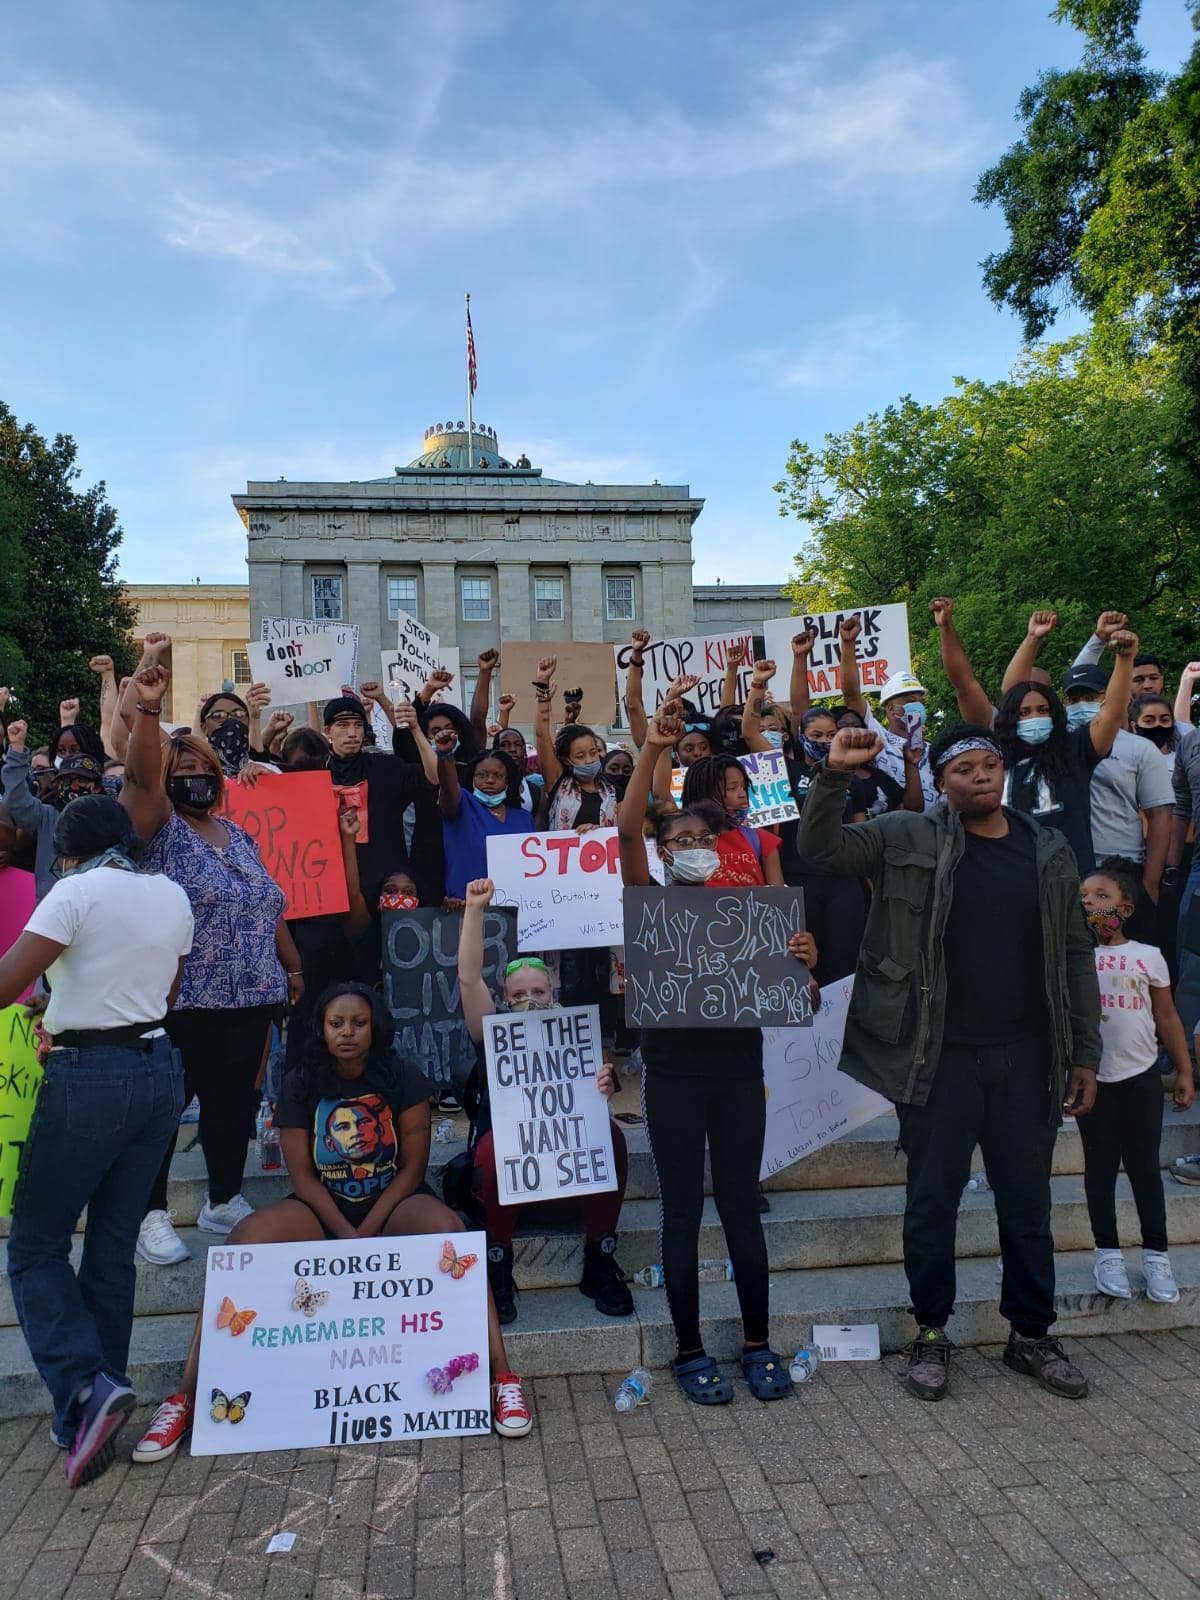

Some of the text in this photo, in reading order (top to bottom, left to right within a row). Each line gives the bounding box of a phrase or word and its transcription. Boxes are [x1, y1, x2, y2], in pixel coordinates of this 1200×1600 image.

[404, 619, 431, 646] STOP
[617, 641, 694, 683] STOP
[806, 659, 889, 693] MATER
[521, 836, 620, 878] STOP
[493, 1014, 591, 1053] BE THE
[496, 1046, 595, 1087] CHANGE
[523, 1082, 574, 1119] YOU
[775, 1088, 841, 1135] Tone
[519, 1116, 584, 1155] WANT
[505, 1148, 607, 1191] TO SEE
[211, 1251, 254, 1271] RIP
[294, 1253, 401, 1277] GEORGE
[352, 1277, 433, 1300] FLOYD
[251, 1311, 444, 1348] REMEMBER HIS
[330, 1344, 403, 1370] NAME
[313, 1381, 401, 1410] BLACK
[330, 1409, 491, 1444] lives MATTER
